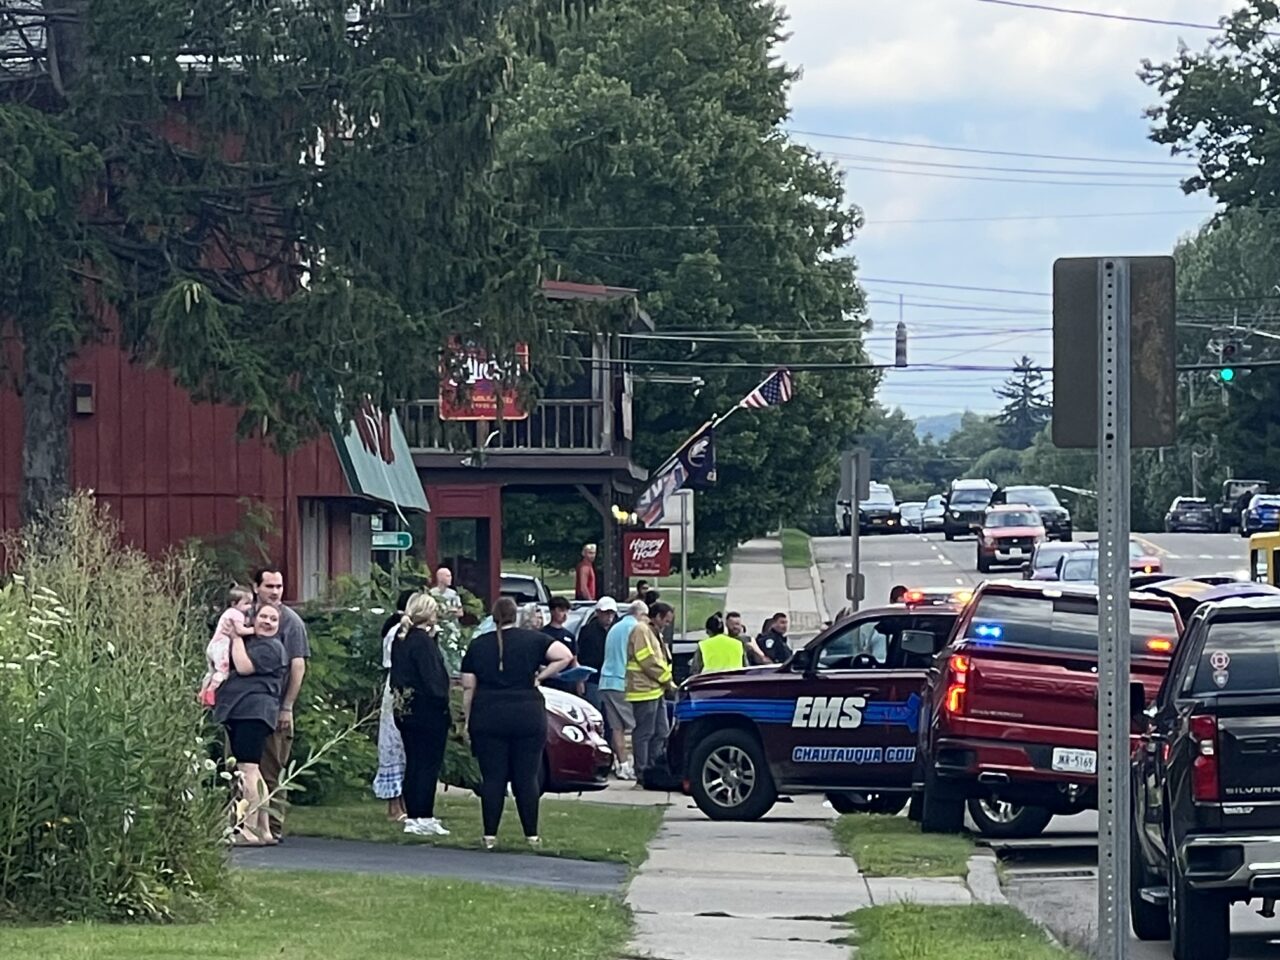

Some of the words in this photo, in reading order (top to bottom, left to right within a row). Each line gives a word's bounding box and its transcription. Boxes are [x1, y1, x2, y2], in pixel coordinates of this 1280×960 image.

[629, 538, 665, 551] Happy
[632, 549, 660, 560] Hour
[792, 697, 866, 728] EMS
[792, 746, 883, 765] CHAUTAUQUA
